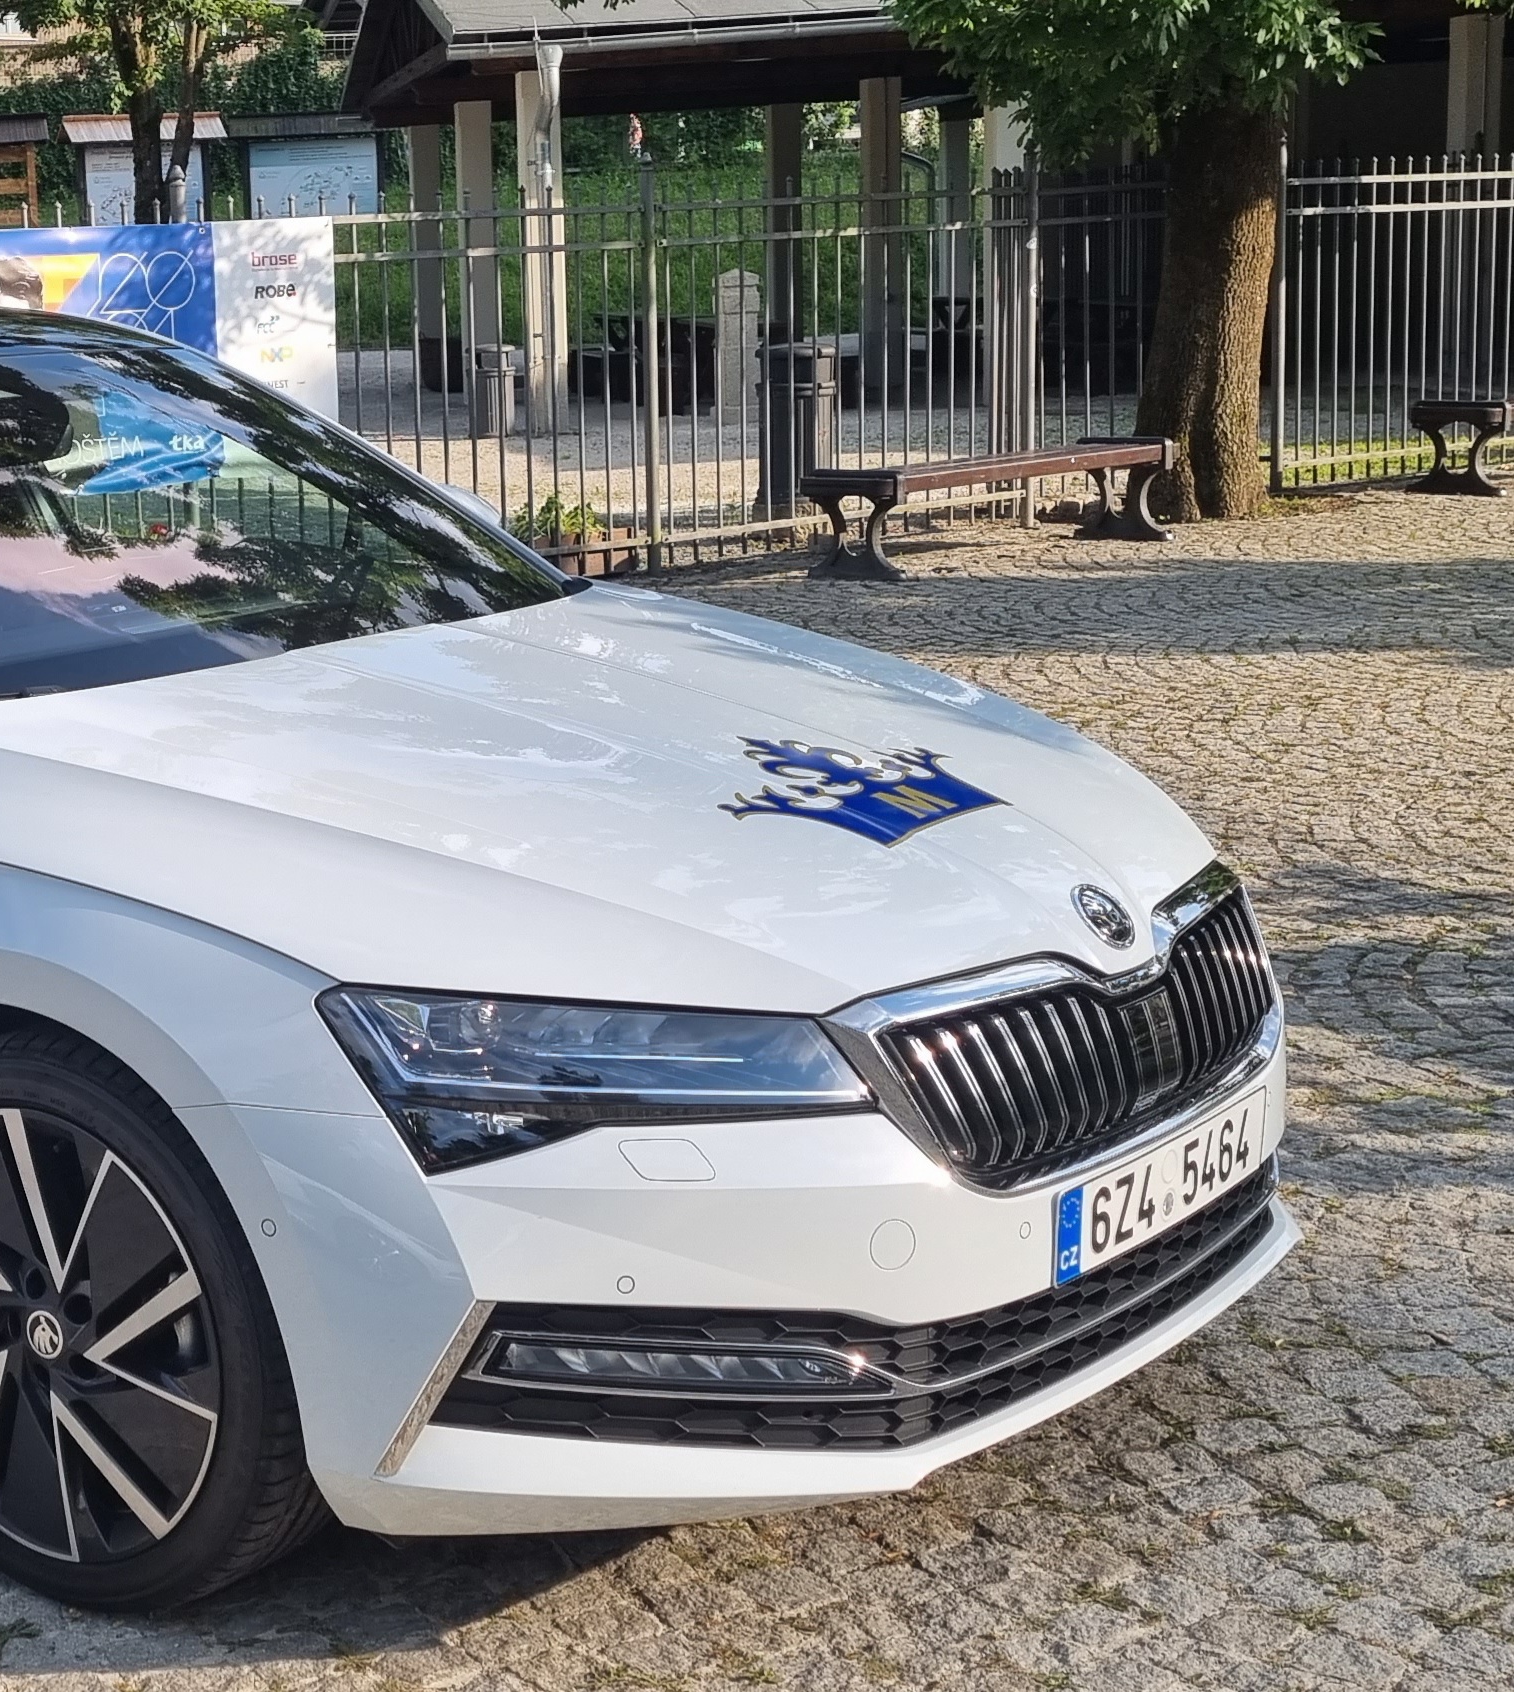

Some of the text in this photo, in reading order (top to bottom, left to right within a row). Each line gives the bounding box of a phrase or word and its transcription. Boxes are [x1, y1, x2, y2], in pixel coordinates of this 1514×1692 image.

[251, 252, 297, 267] brose
[260, 346, 293, 362] NXP
[65, 431, 144, 465] OŠTĚM
[872, 785, 958, 819] M
[1060, 1107, 1250, 1271] CZ 6Z4 5464
